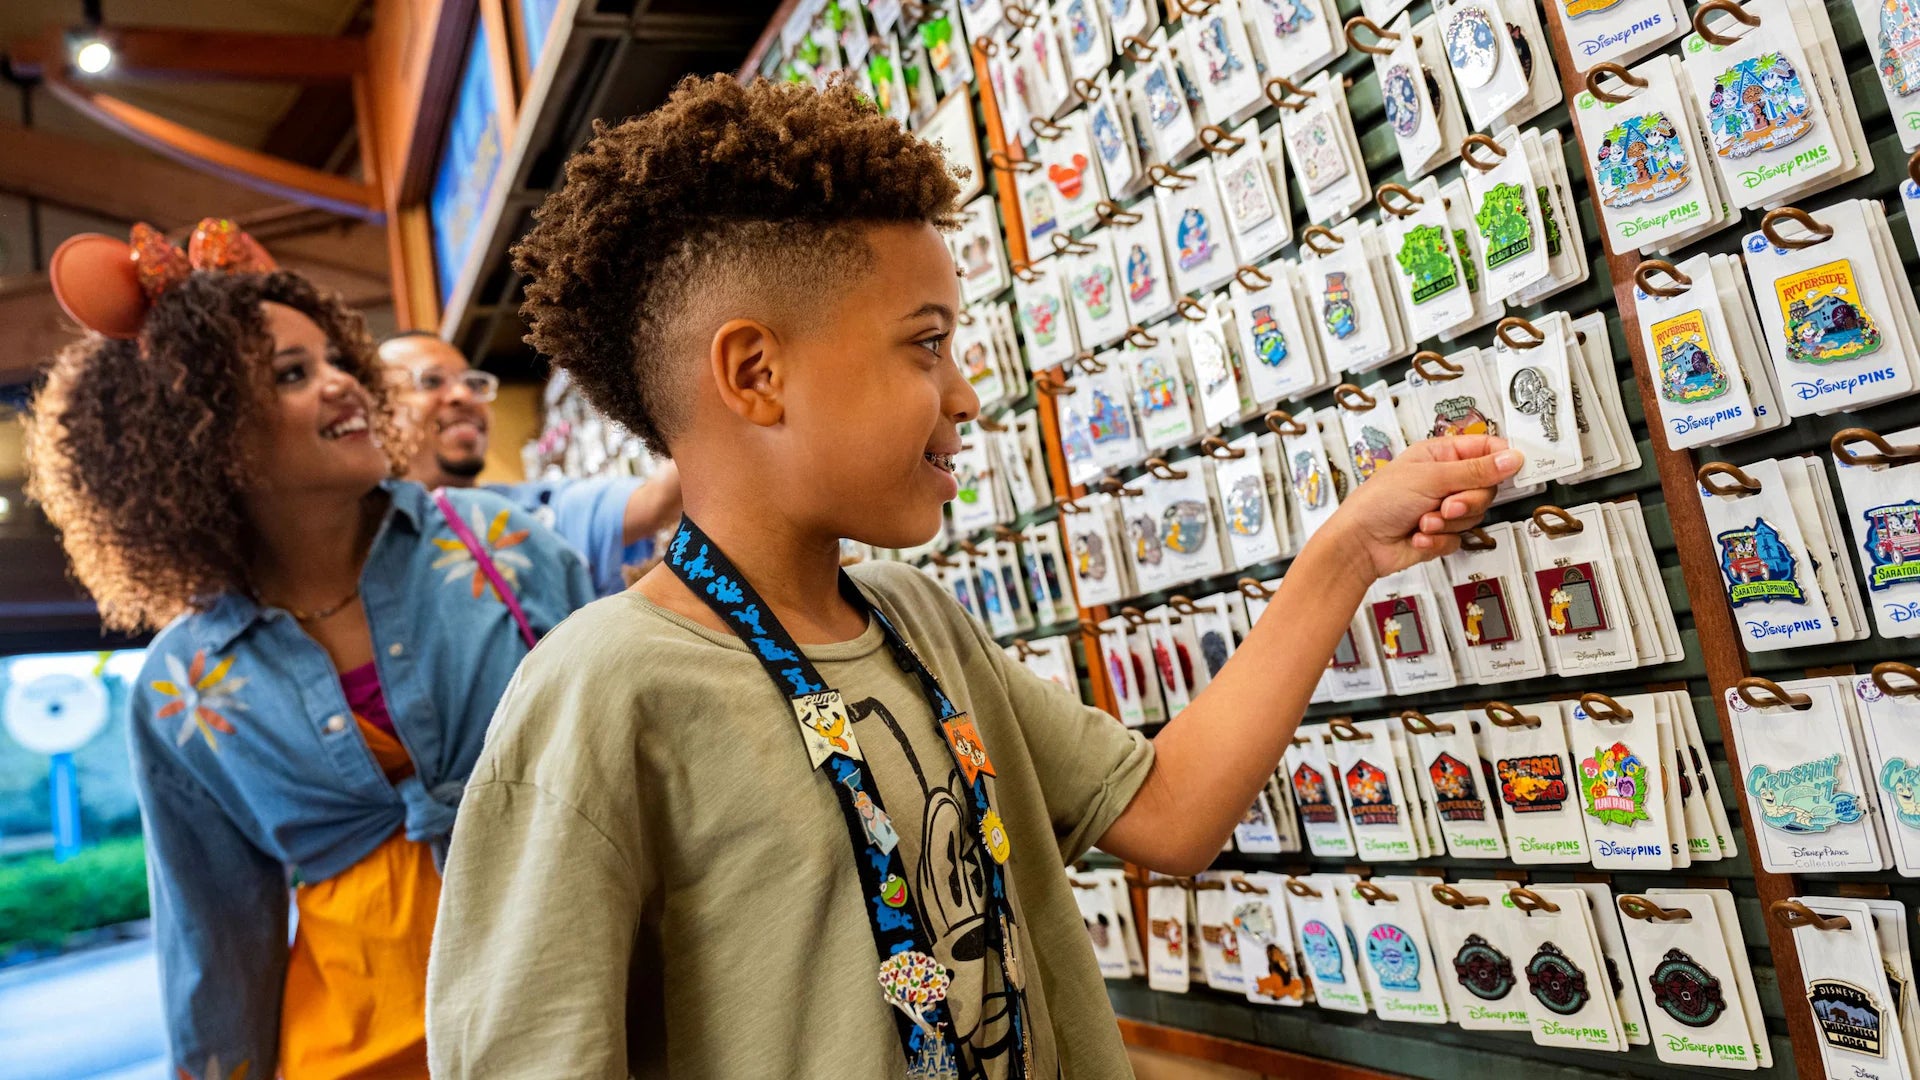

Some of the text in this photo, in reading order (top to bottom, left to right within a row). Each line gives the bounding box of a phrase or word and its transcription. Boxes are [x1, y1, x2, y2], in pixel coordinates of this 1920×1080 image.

[1783, 273, 1849, 302] RIVERSIDE
[1656, 321, 1702, 346] RIVERSIDE
[1733, 585, 1765, 598] SARATOGA
[1766, 583, 1796, 594] SPRINGS
[803, 691, 839, 705] PLUTO
[1794, 858, 1848, 869] Collection
[1819, 986, 1862, 1001] DISNEY'S
[1824, 1021, 1876, 1039] WILDERNESS
[1837, 1034, 1868, 1048] LODGE
